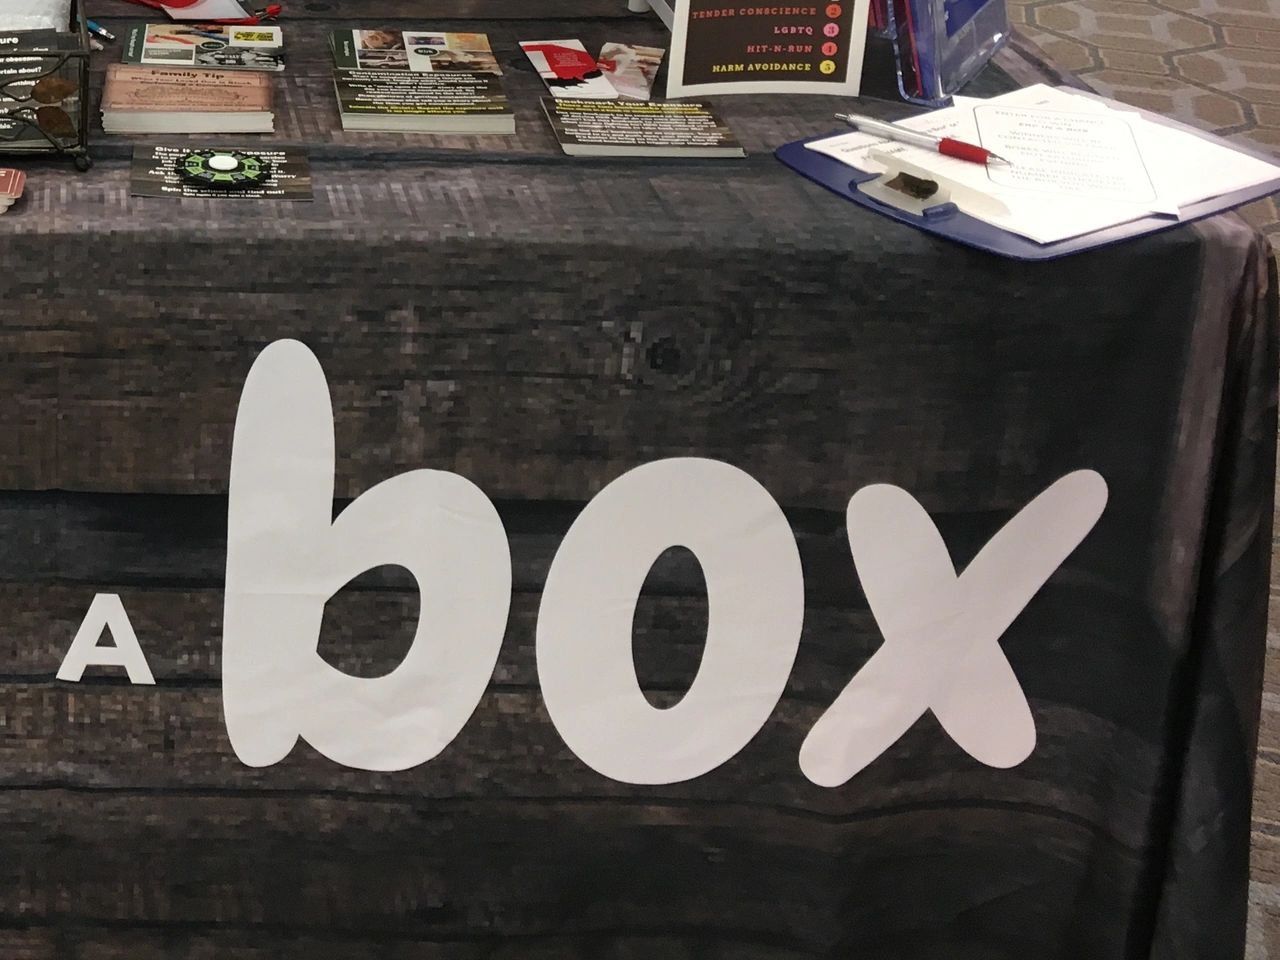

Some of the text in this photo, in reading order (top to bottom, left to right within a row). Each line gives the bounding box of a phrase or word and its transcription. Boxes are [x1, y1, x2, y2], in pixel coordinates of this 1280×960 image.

[692, 8, 736, 19] TENDER
[739, 7, 817, 17] CONSCIENCE
[774, 26, 814, 36] LGBTQ
[746, 45, 813, 54] HIT-N-RUN
[712, 64, 745, 73] HARM
[747, 63, 812, 72] AVOIDANCE
[151, 70, 198, 78] Family
[55, 593, 156, 685] A
[221, 337, 1109, 788] box
